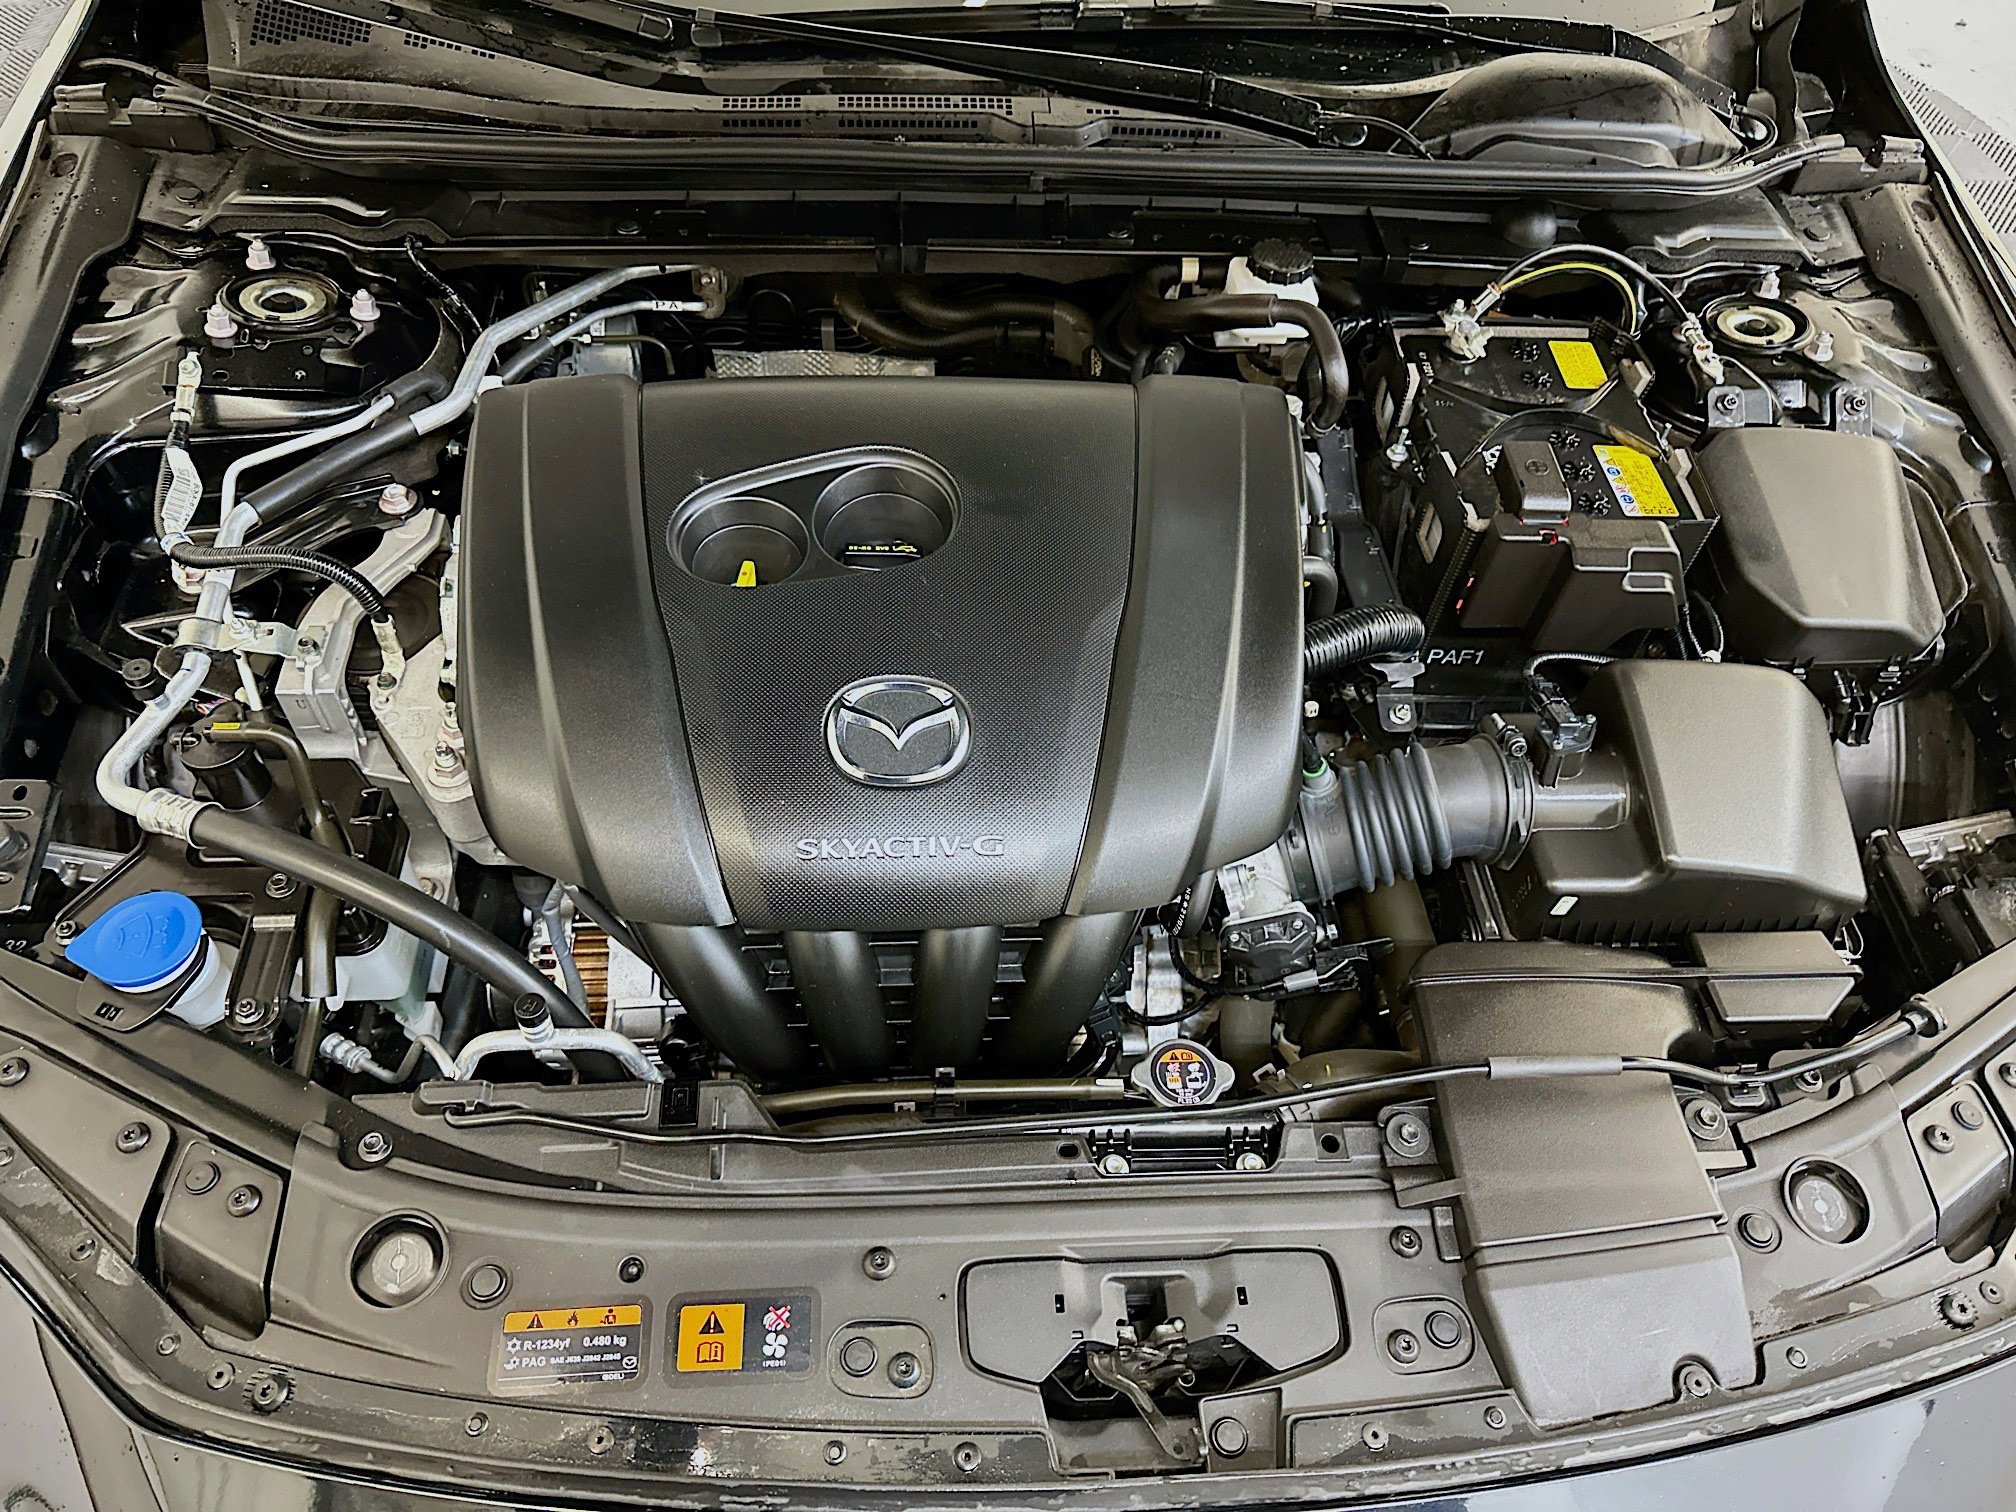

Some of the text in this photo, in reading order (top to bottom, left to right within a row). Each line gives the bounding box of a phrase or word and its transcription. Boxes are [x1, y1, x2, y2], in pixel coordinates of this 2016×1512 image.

[1426, 649, 1485, 665] PAF1
[796, 835, 1005, 860] SKYACTIV-G
[523, 1334, 627, 1351] R-1234yf 0.480 kg
[521, 1356, 546, 1368] PAG
